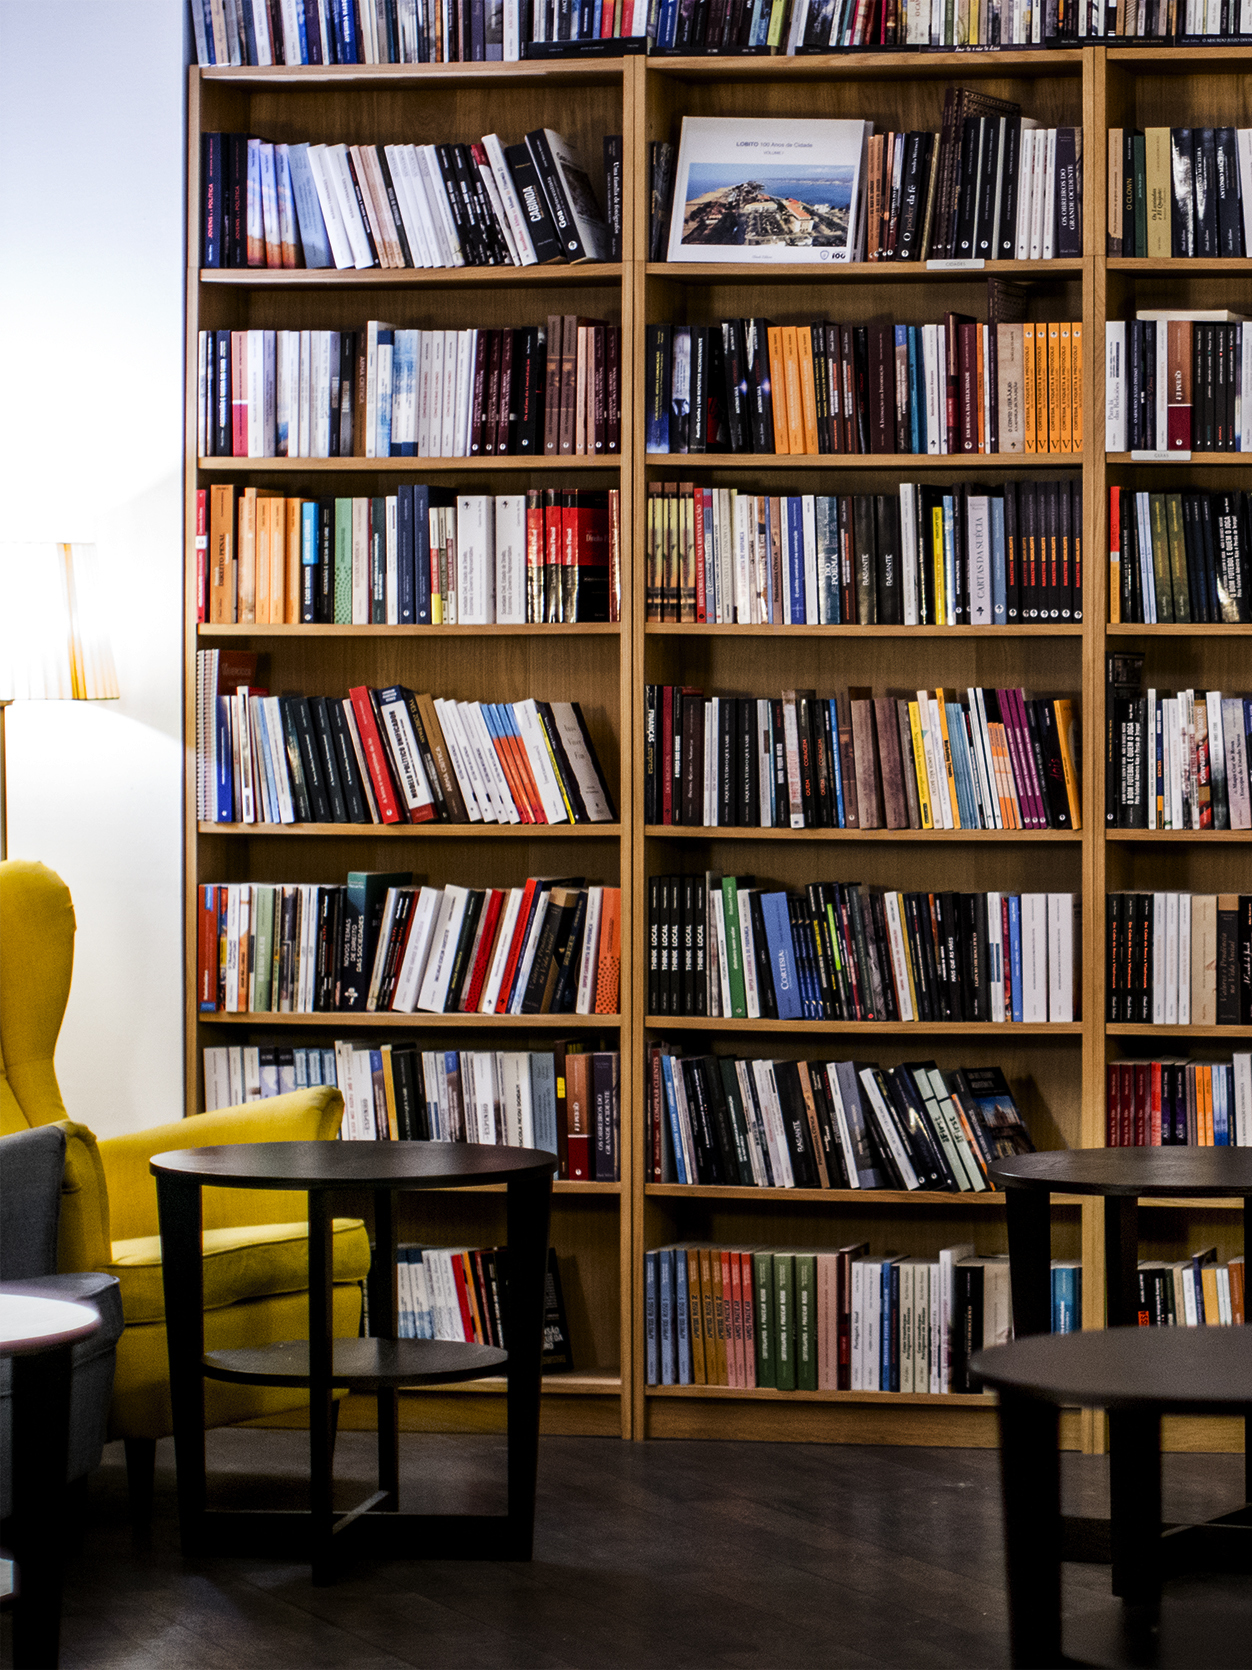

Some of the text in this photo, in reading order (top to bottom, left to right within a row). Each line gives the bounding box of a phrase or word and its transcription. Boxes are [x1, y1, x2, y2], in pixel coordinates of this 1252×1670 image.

[342, 15, 351, 42] AVENIDA
[1060, 169, 1067, 179] DO
[523, 186, 541, 221] CABINDA
[906, 208, 915, 230] poder
[1224, 516, 1232, 529] JOGA
[1225, 536, 1234, 550] QUEM
[824, 563, 831, 575] DO
[974, 517, 984, 598] CARTAS DA SUÉCIA
[1226, 557, 1235, 580] FUTEBOL
[1228, 582, 1236, 592] BOM
[409, 699, 425, 743] YVES ZOBERMAN
[390, 710, 417, 798] MODELO POLÍTICO UNIFICADOR
[435, 746, 453, 792] ARMA CRÍTICA
[1050, 758, 1062, 781] dois
[778, 950, 788, 989] CORTESIA:
[793, 1121, 803, 1152] RASANTE
